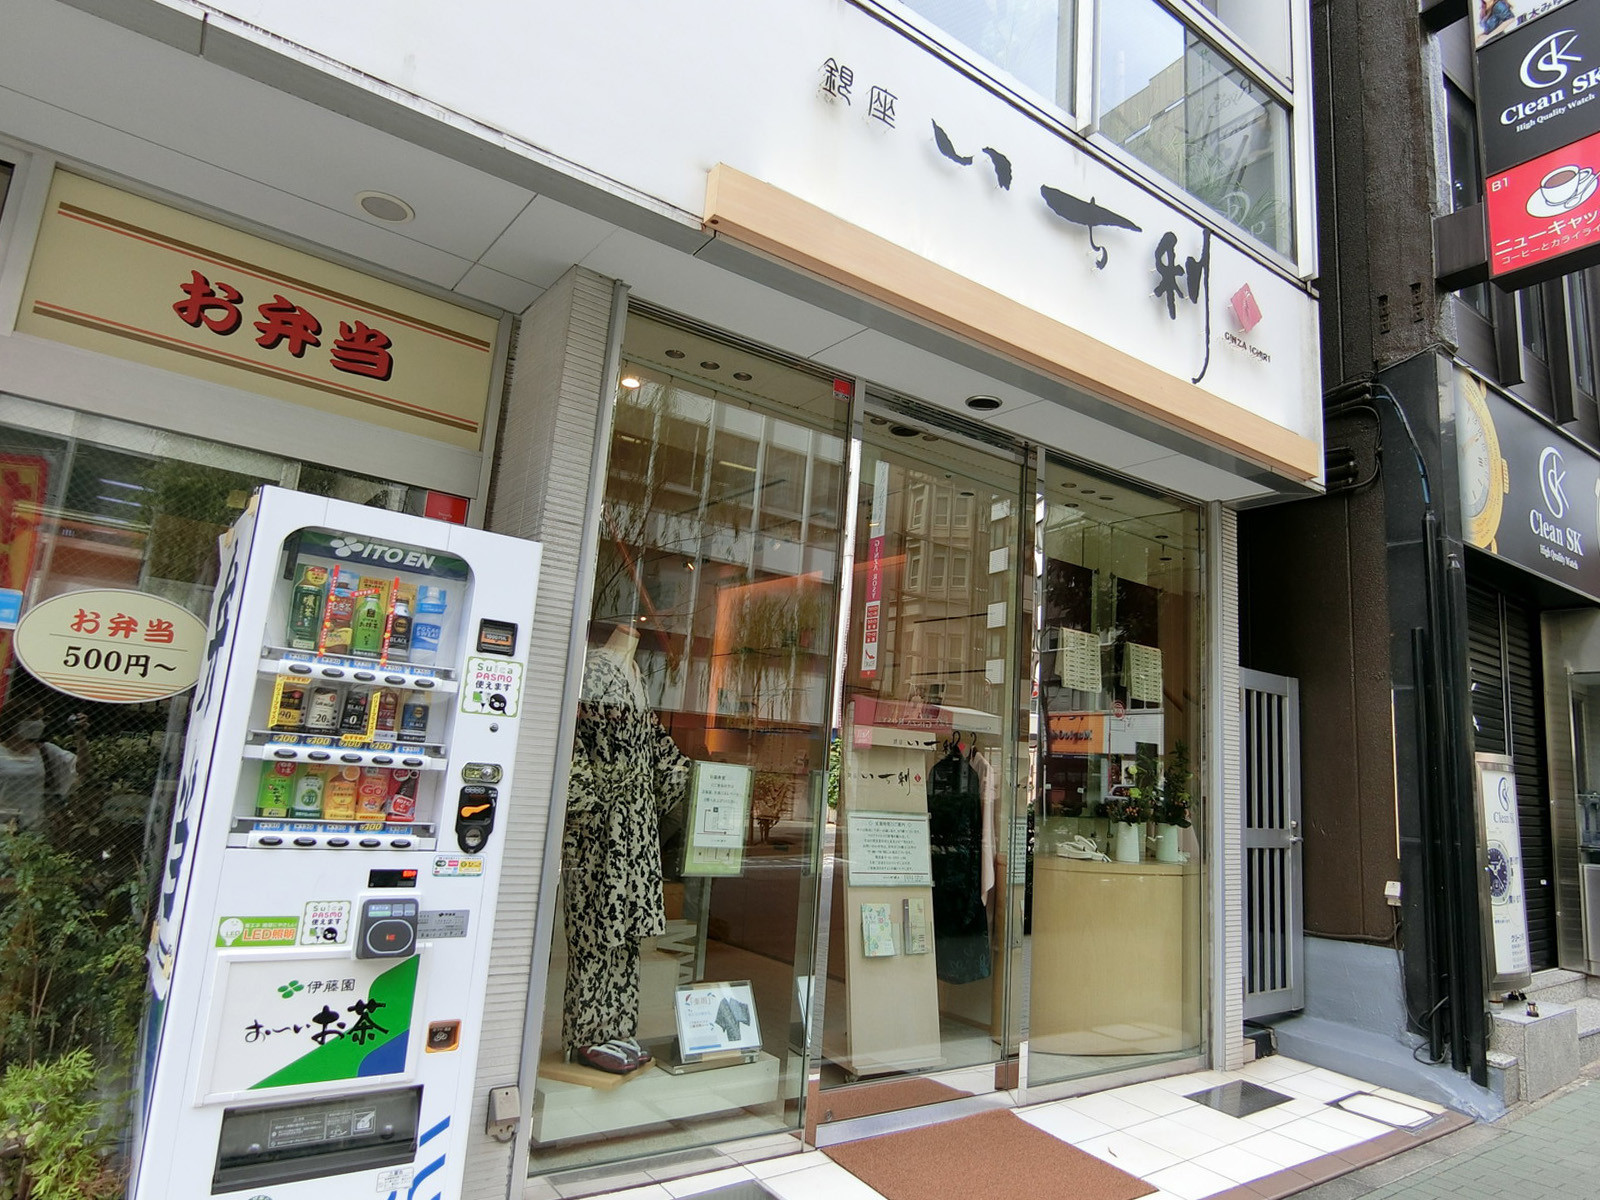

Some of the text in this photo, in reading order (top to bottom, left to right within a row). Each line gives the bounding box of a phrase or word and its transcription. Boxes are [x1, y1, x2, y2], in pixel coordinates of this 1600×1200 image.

[823, 56, 898, 130] 銀座
[1500, 89, 1565, 125] Clean
[1516, 93, 1596, 133] High Quality Watch
[1491, 177, 1509, 192] B1
[172, 269, 393, 381] お弁当
[1529, 509, 1584, 556] Clean SK
[361, 543, 436, 570] ITO EN
[70, 608, 175, 644] お弁当
[477, 662, 513, 675] Suica
[476, 672, 513, 683] PASMO
[475, 680, 511, 692] 使えます
[315, 713, 327, 723] 20
[311, 911, 343, 919] PASMO
[243, 927, 297, 941] LED照明
[307, 978, 356, 994] 伊藤園
